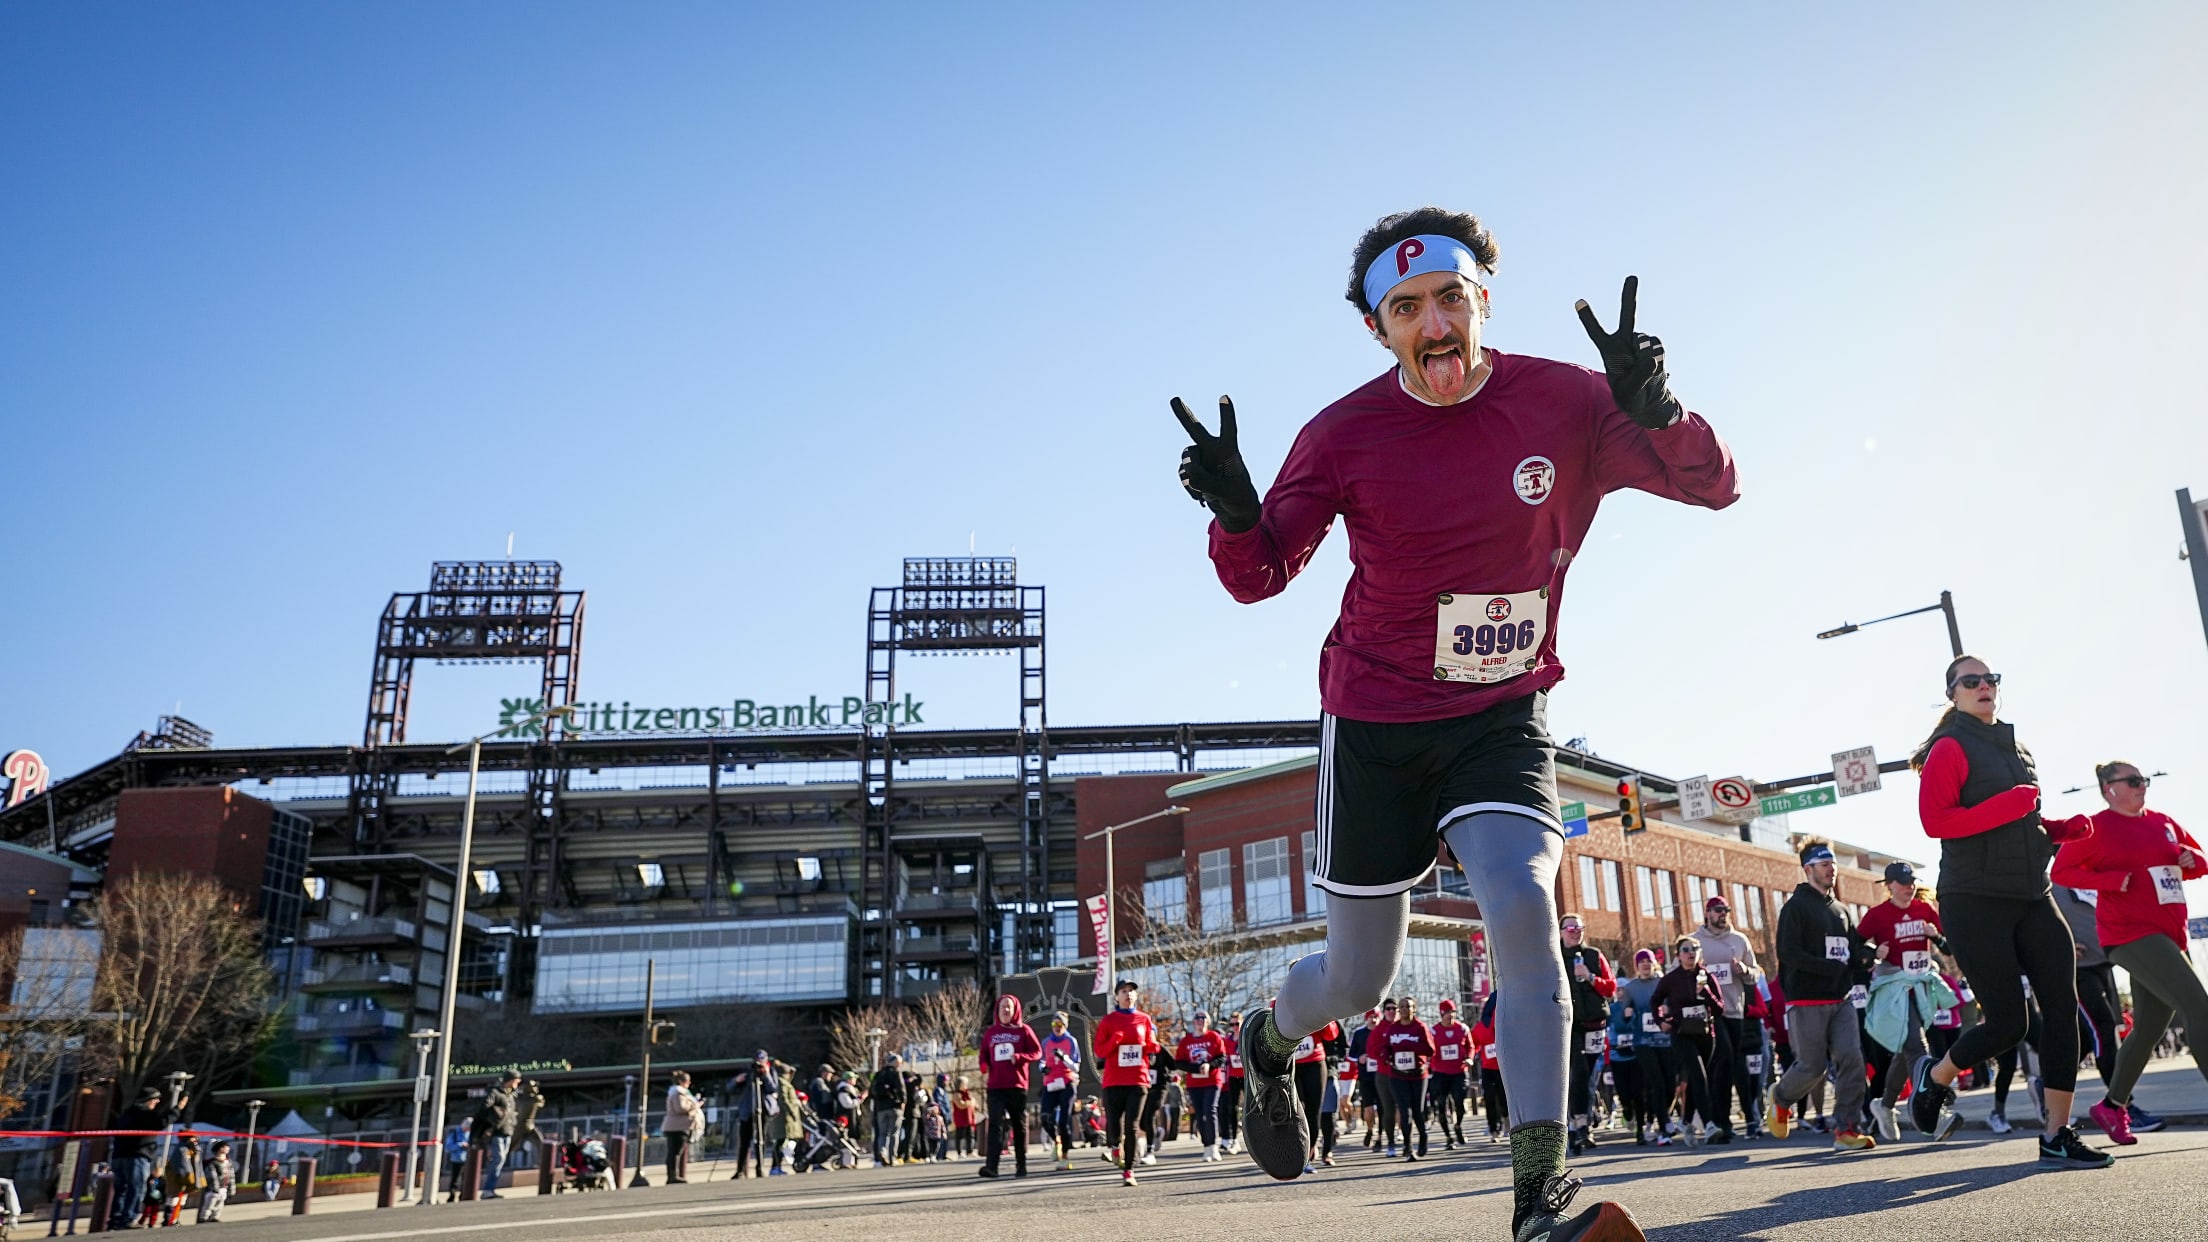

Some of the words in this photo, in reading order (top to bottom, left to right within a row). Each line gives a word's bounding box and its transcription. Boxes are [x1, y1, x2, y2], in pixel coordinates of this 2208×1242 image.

[1395, 237, 1426, 279] P
[1517, 467, 1553, 497] 5K
[1453, 619, 1535, 656] 3996
[1481, 657, 1508, 666] ALFRED
[562, 700, 721, 733] Citizens
[733, 695, 828, 728] Bank
[842, 692, 926, 726] Park
[1685, 780, 1701, 792] NO
[1841, 784, 1856, 794] THE
[1860, 780, 1877, 791] BOX
[1686, 791, 1705, 801] TURN
[1767, 798, 1792, 812] 11th
[1798, 794, 1812, 807] St
[1691, 801, 1702, 809] ON
[1690, 809, 1705, 818] RED
[1090, 898, 1109, 992] Phillies
